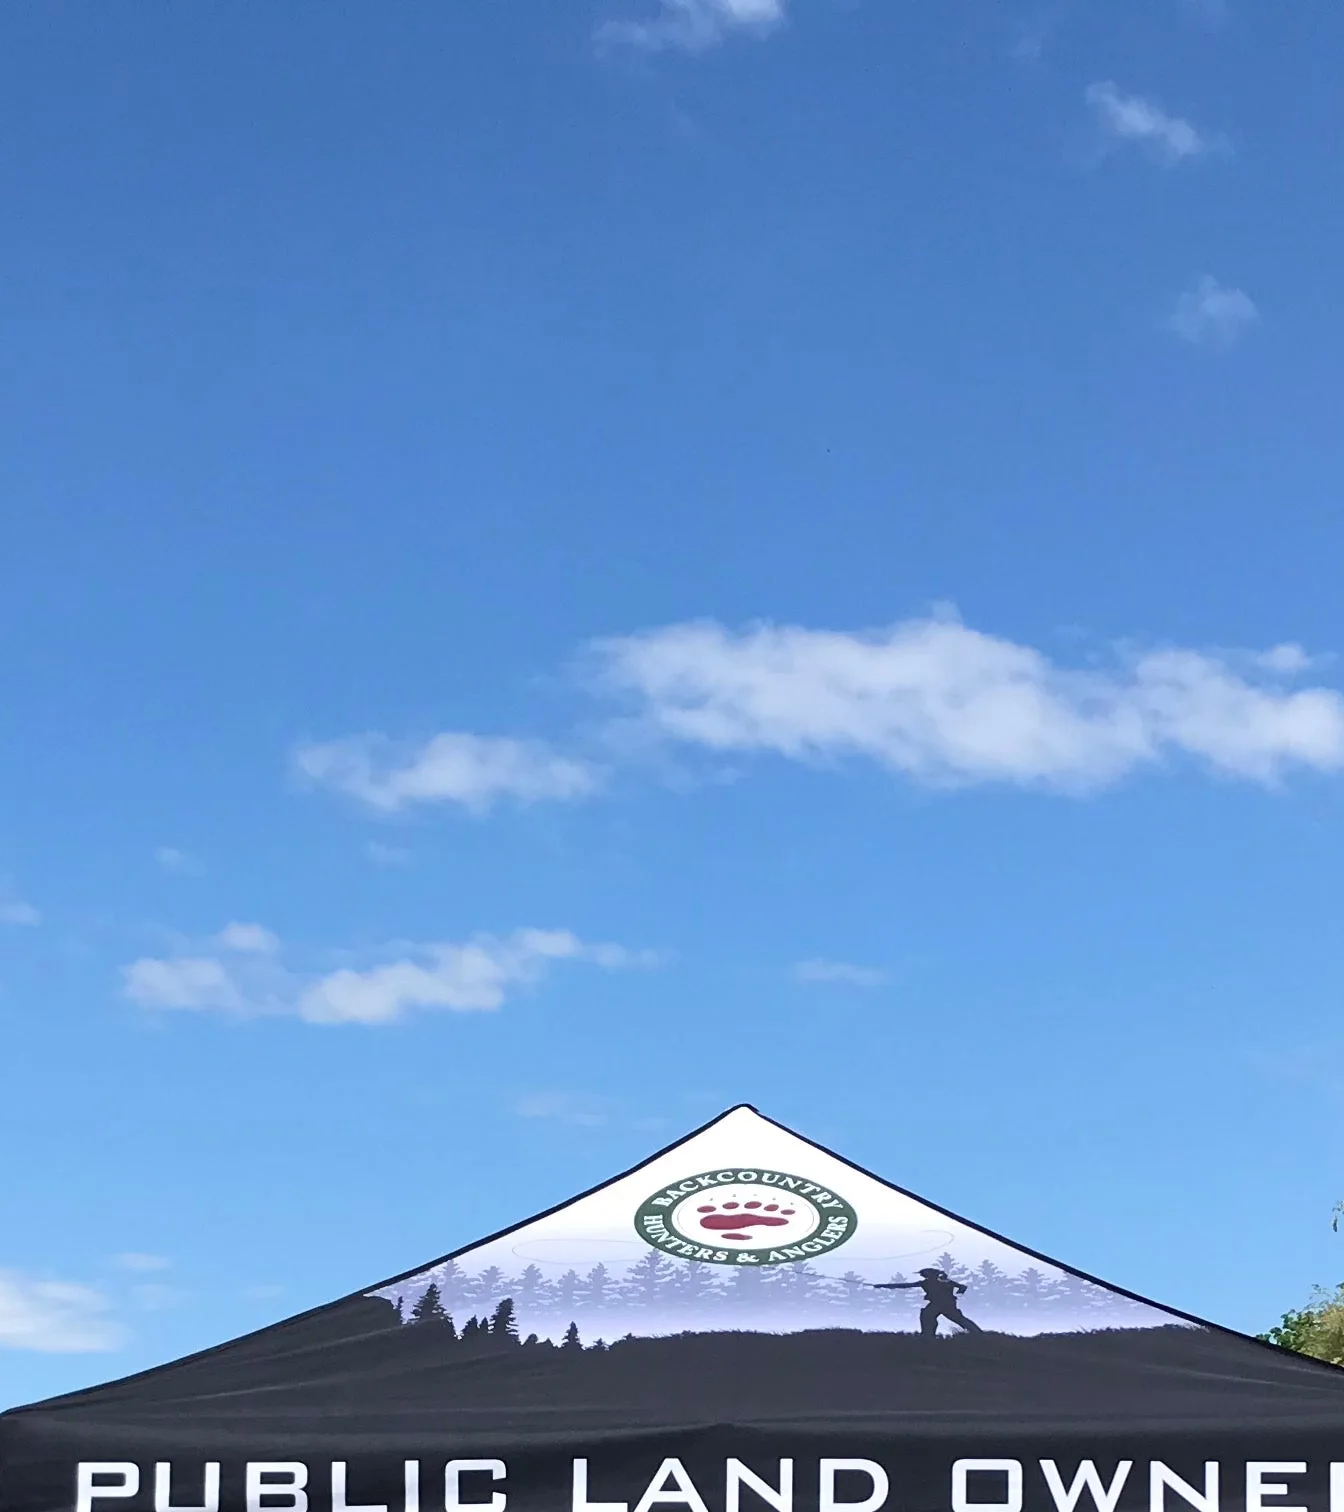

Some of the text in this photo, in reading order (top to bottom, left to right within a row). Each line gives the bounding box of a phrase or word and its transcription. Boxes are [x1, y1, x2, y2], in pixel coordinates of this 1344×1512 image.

[651, 1170, 844, 1210] BACKCOUNTRY
[643, 1214, 850, 1263] HUNTERS & ANGLERS
